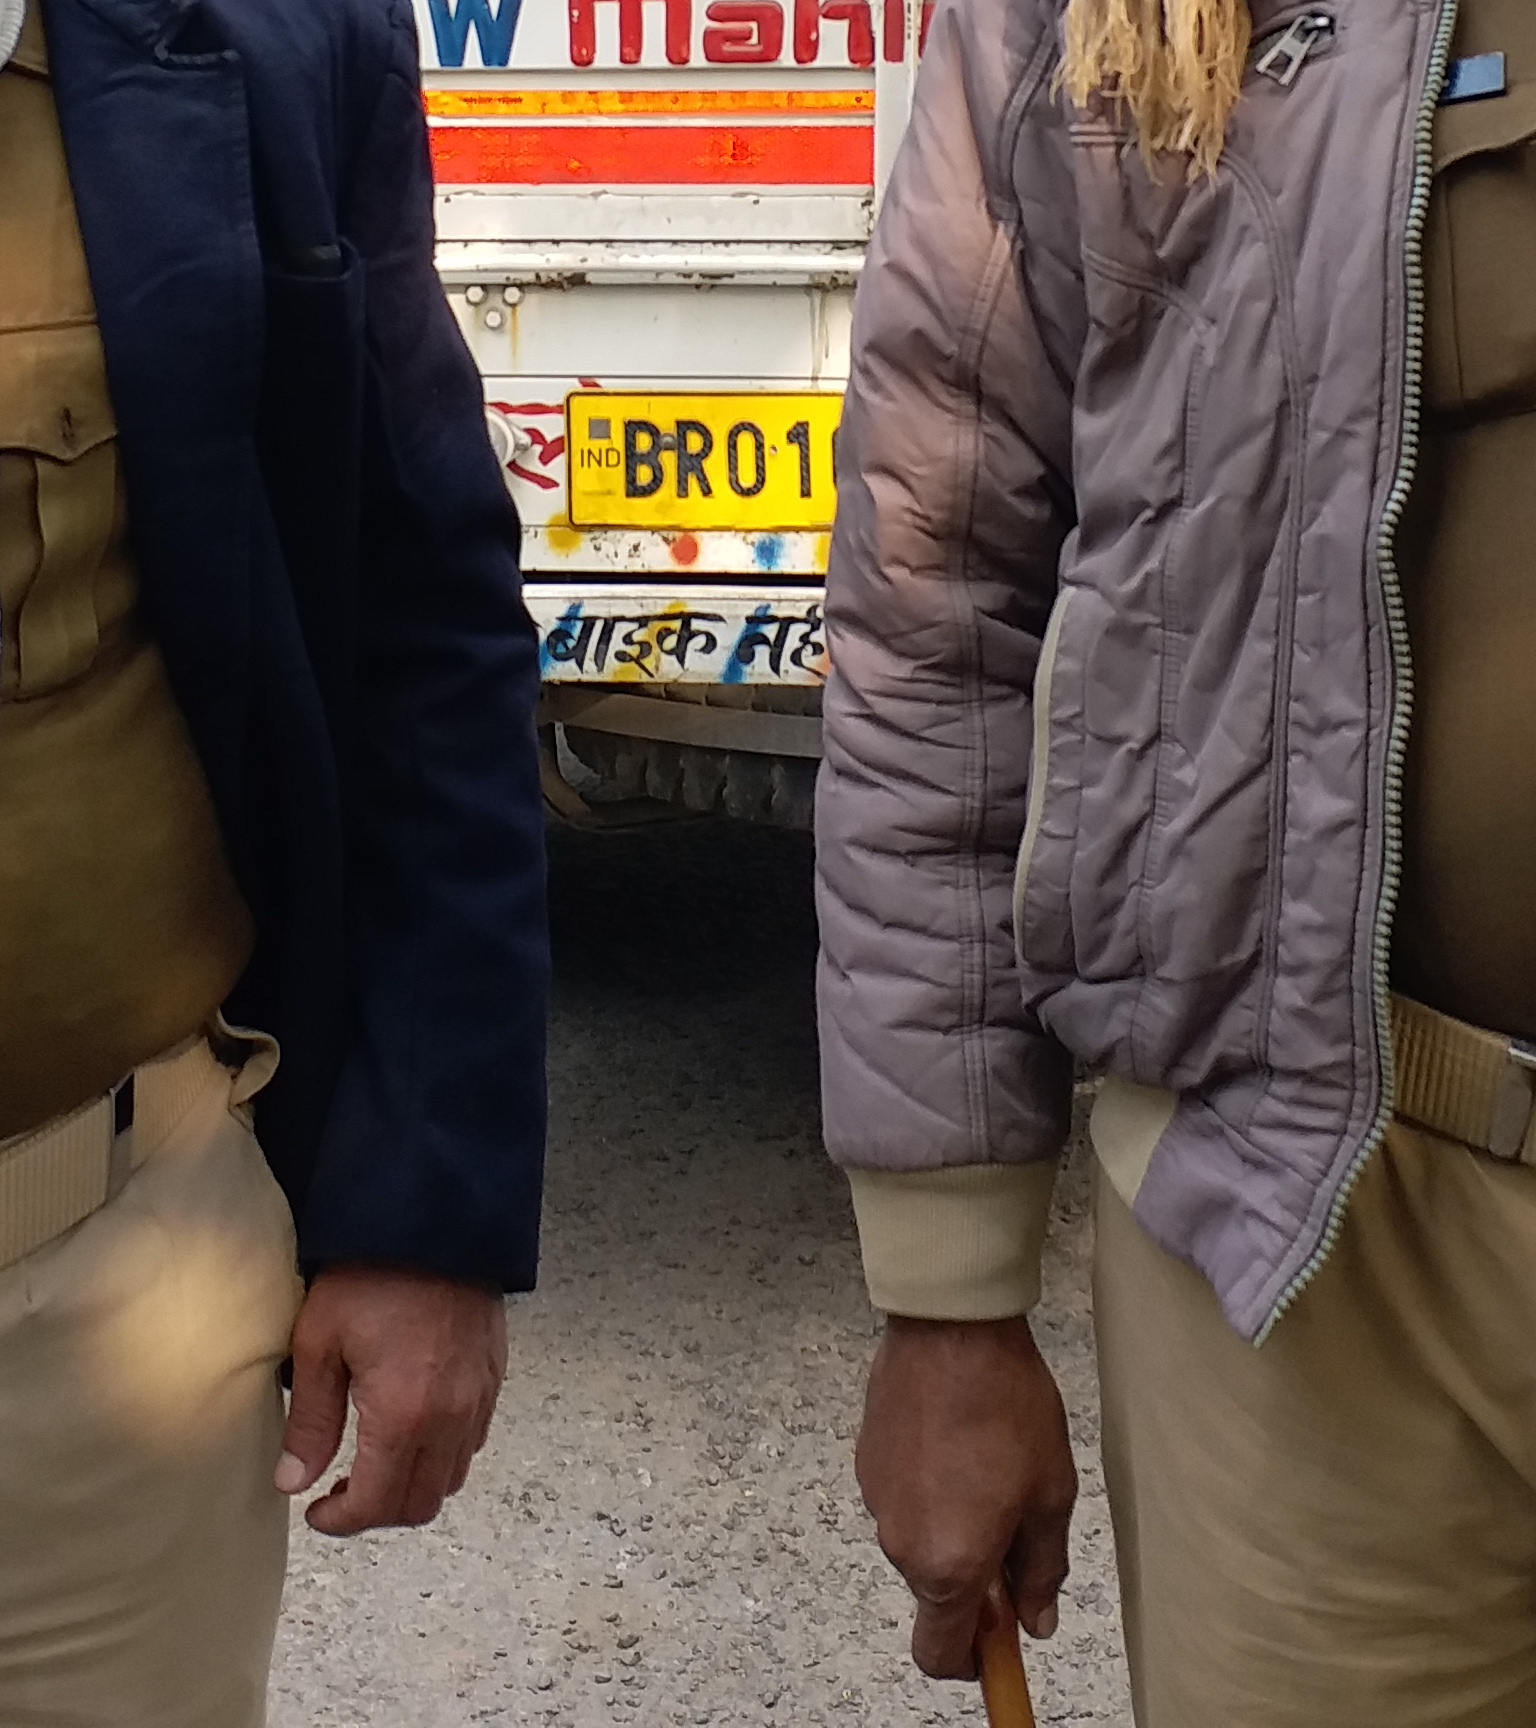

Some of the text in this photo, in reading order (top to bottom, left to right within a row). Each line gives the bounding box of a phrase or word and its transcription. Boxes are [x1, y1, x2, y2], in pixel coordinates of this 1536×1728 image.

[580, 446, 621, 469] IND
[624, 420, 839, 499] BR01
[547, 611, 727, 678] बाइक
